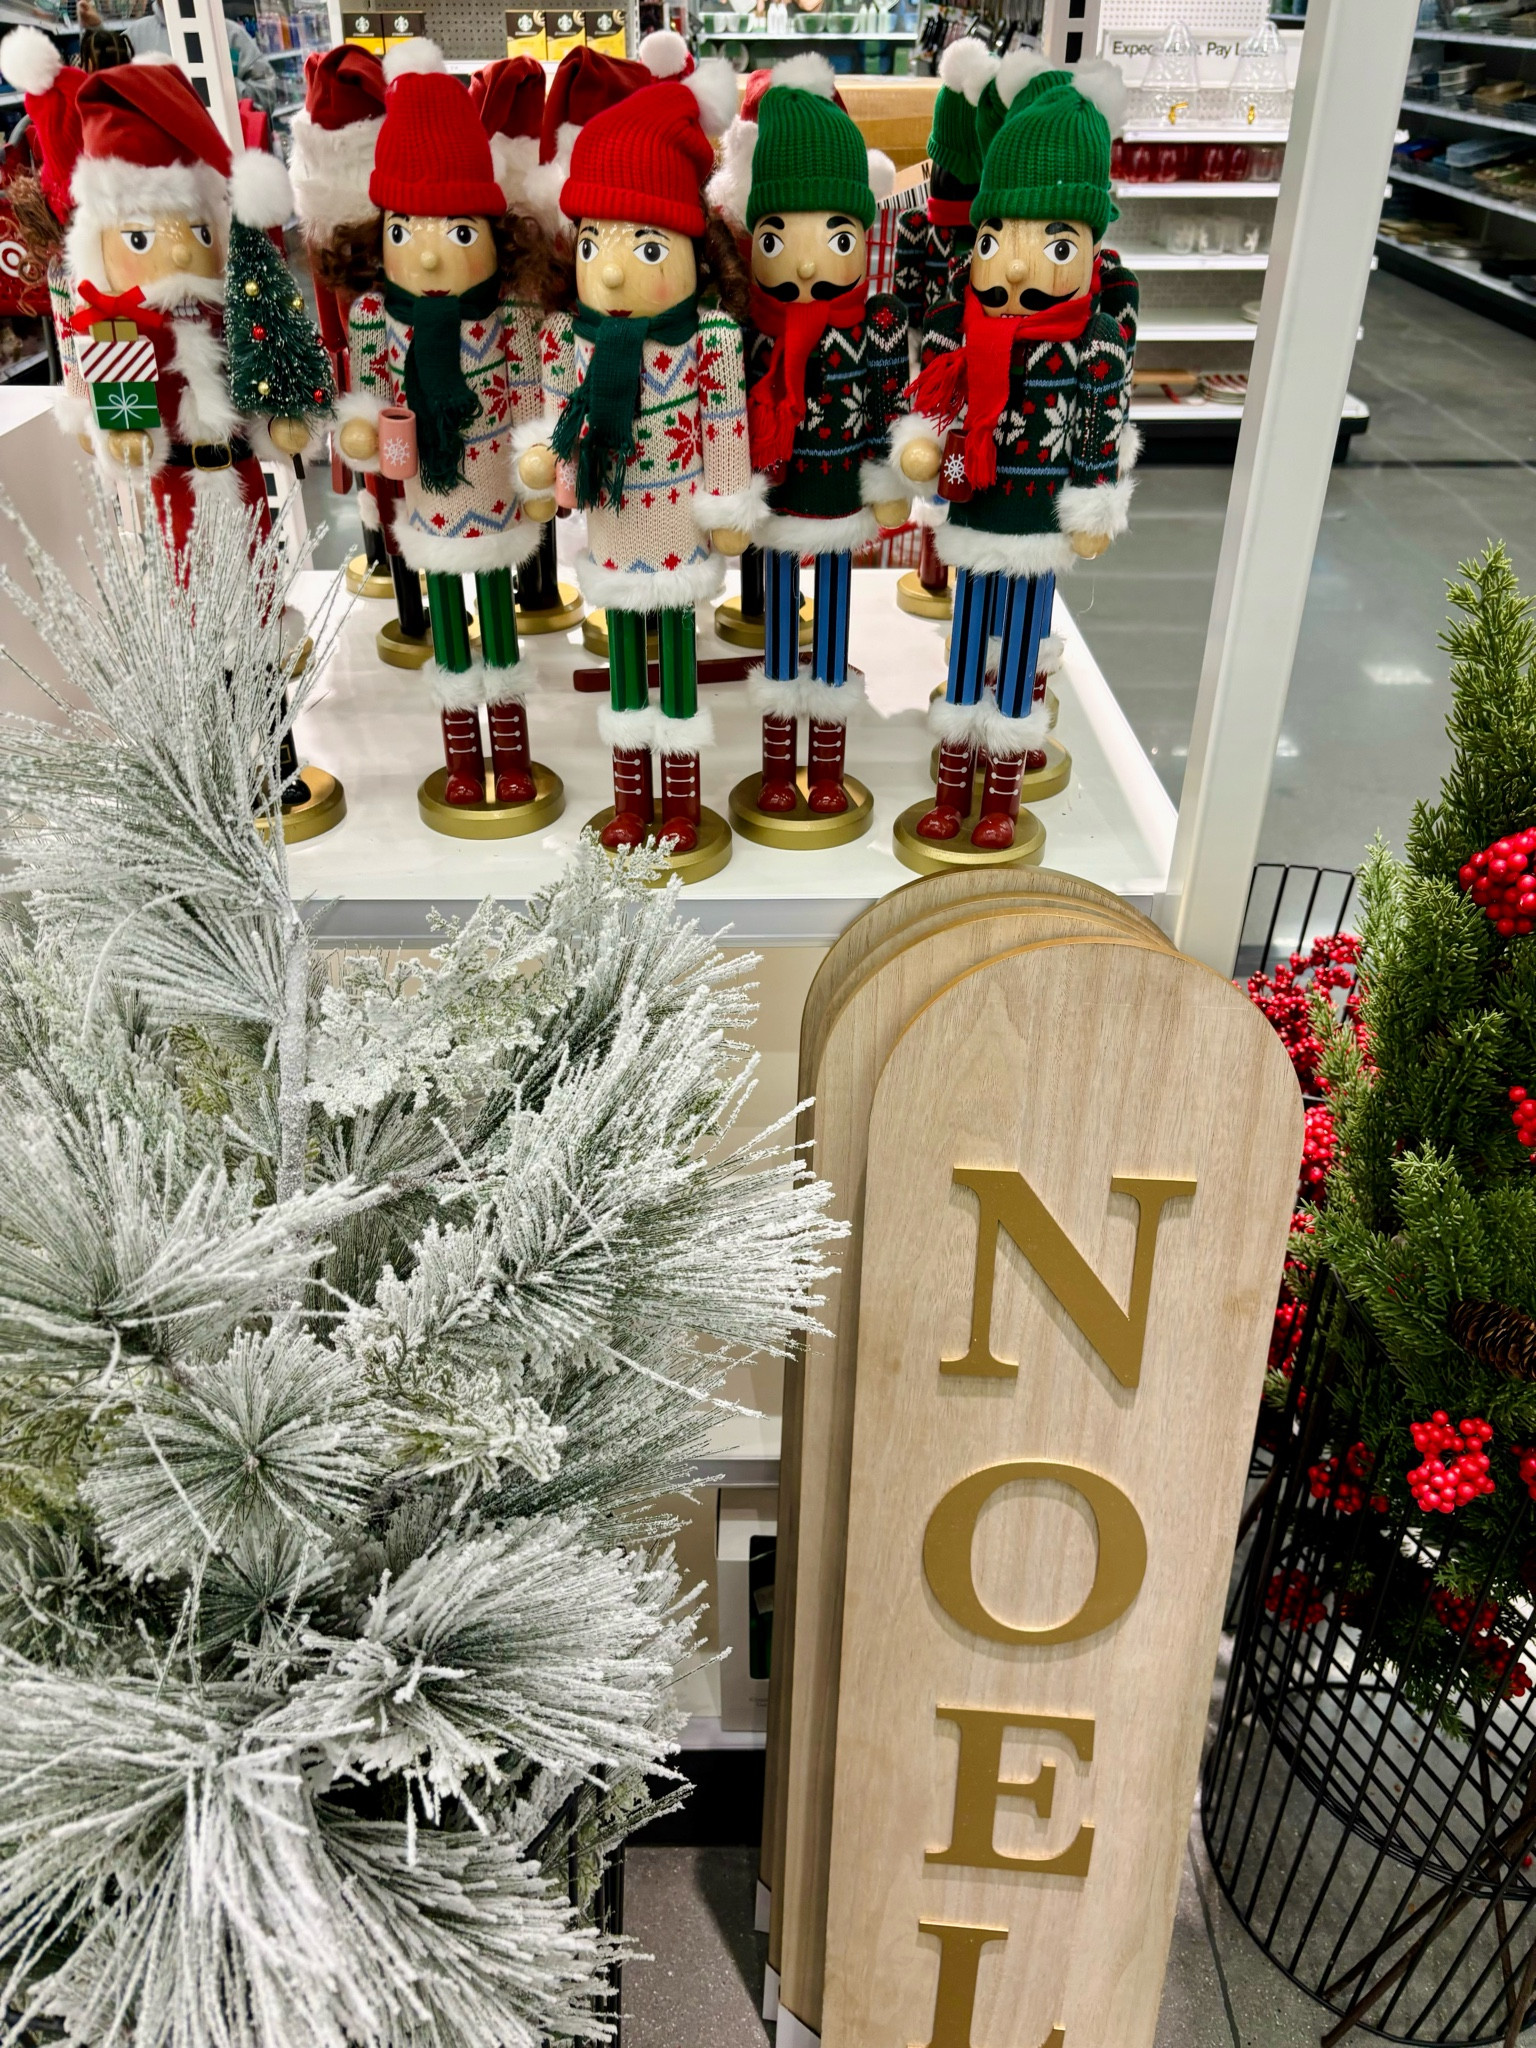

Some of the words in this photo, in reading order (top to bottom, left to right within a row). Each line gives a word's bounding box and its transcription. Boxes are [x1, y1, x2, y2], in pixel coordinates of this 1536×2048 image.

[1112, 41, 1156, 58] Expec
[1206, 41, 1231, 59] Pay
[907, 1164, 1197, 2048] NOEL
